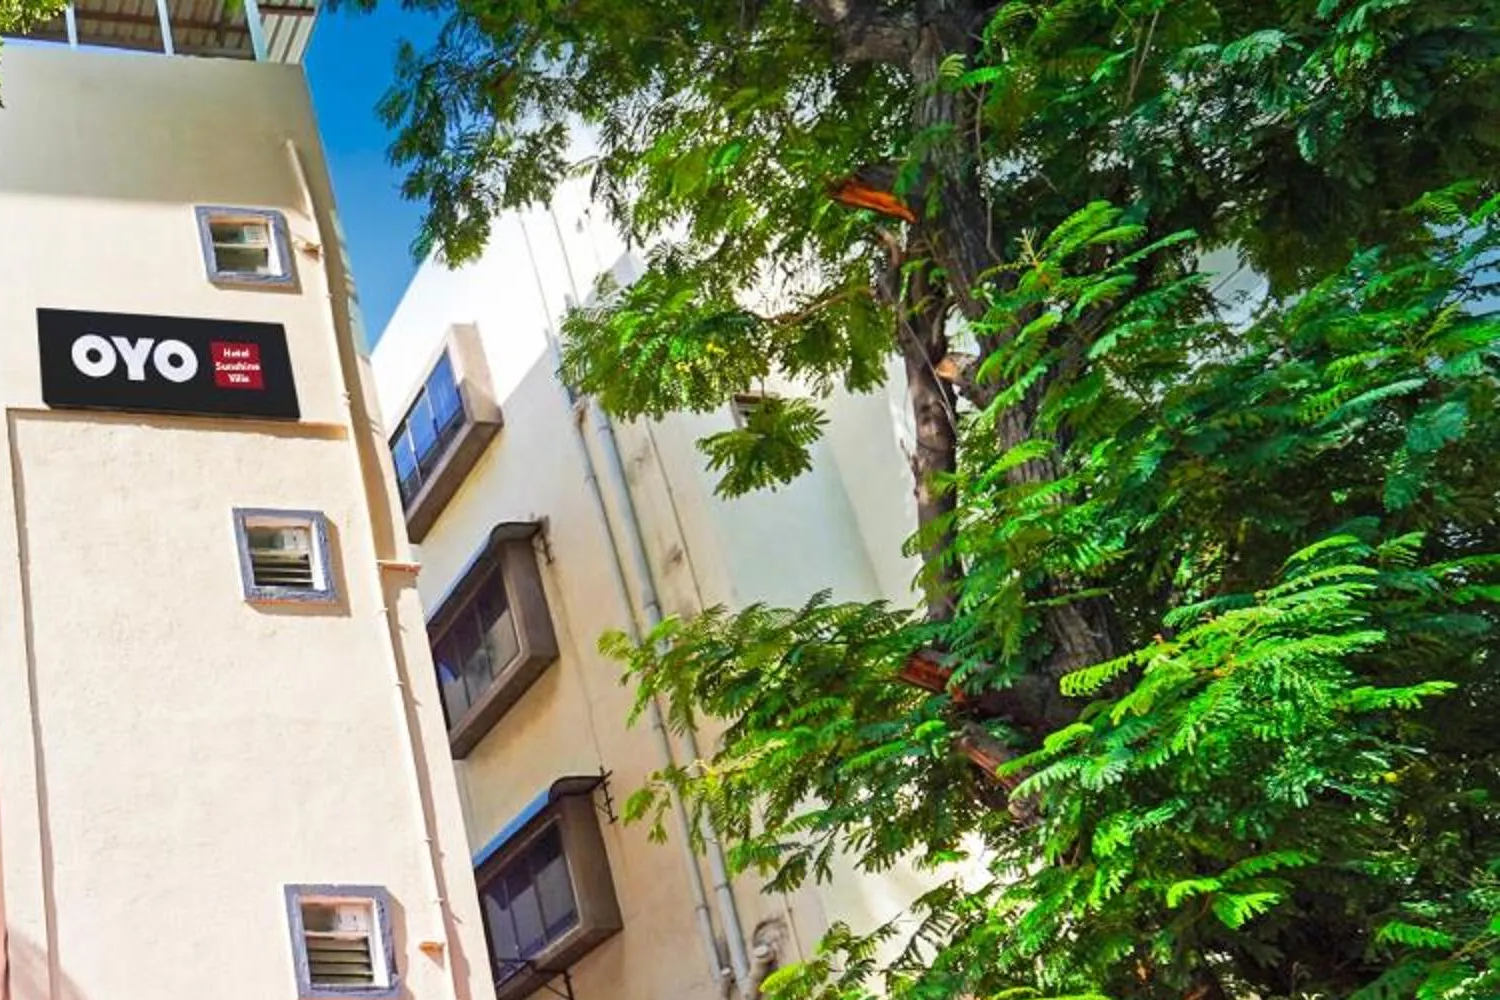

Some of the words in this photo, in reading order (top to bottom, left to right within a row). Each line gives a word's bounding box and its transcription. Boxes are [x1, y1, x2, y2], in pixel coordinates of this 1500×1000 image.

[223, 348, 250, 357] Hotel
[71, 333, 199, 383] OYO
[215, 361, 261, 371] Sunshine
